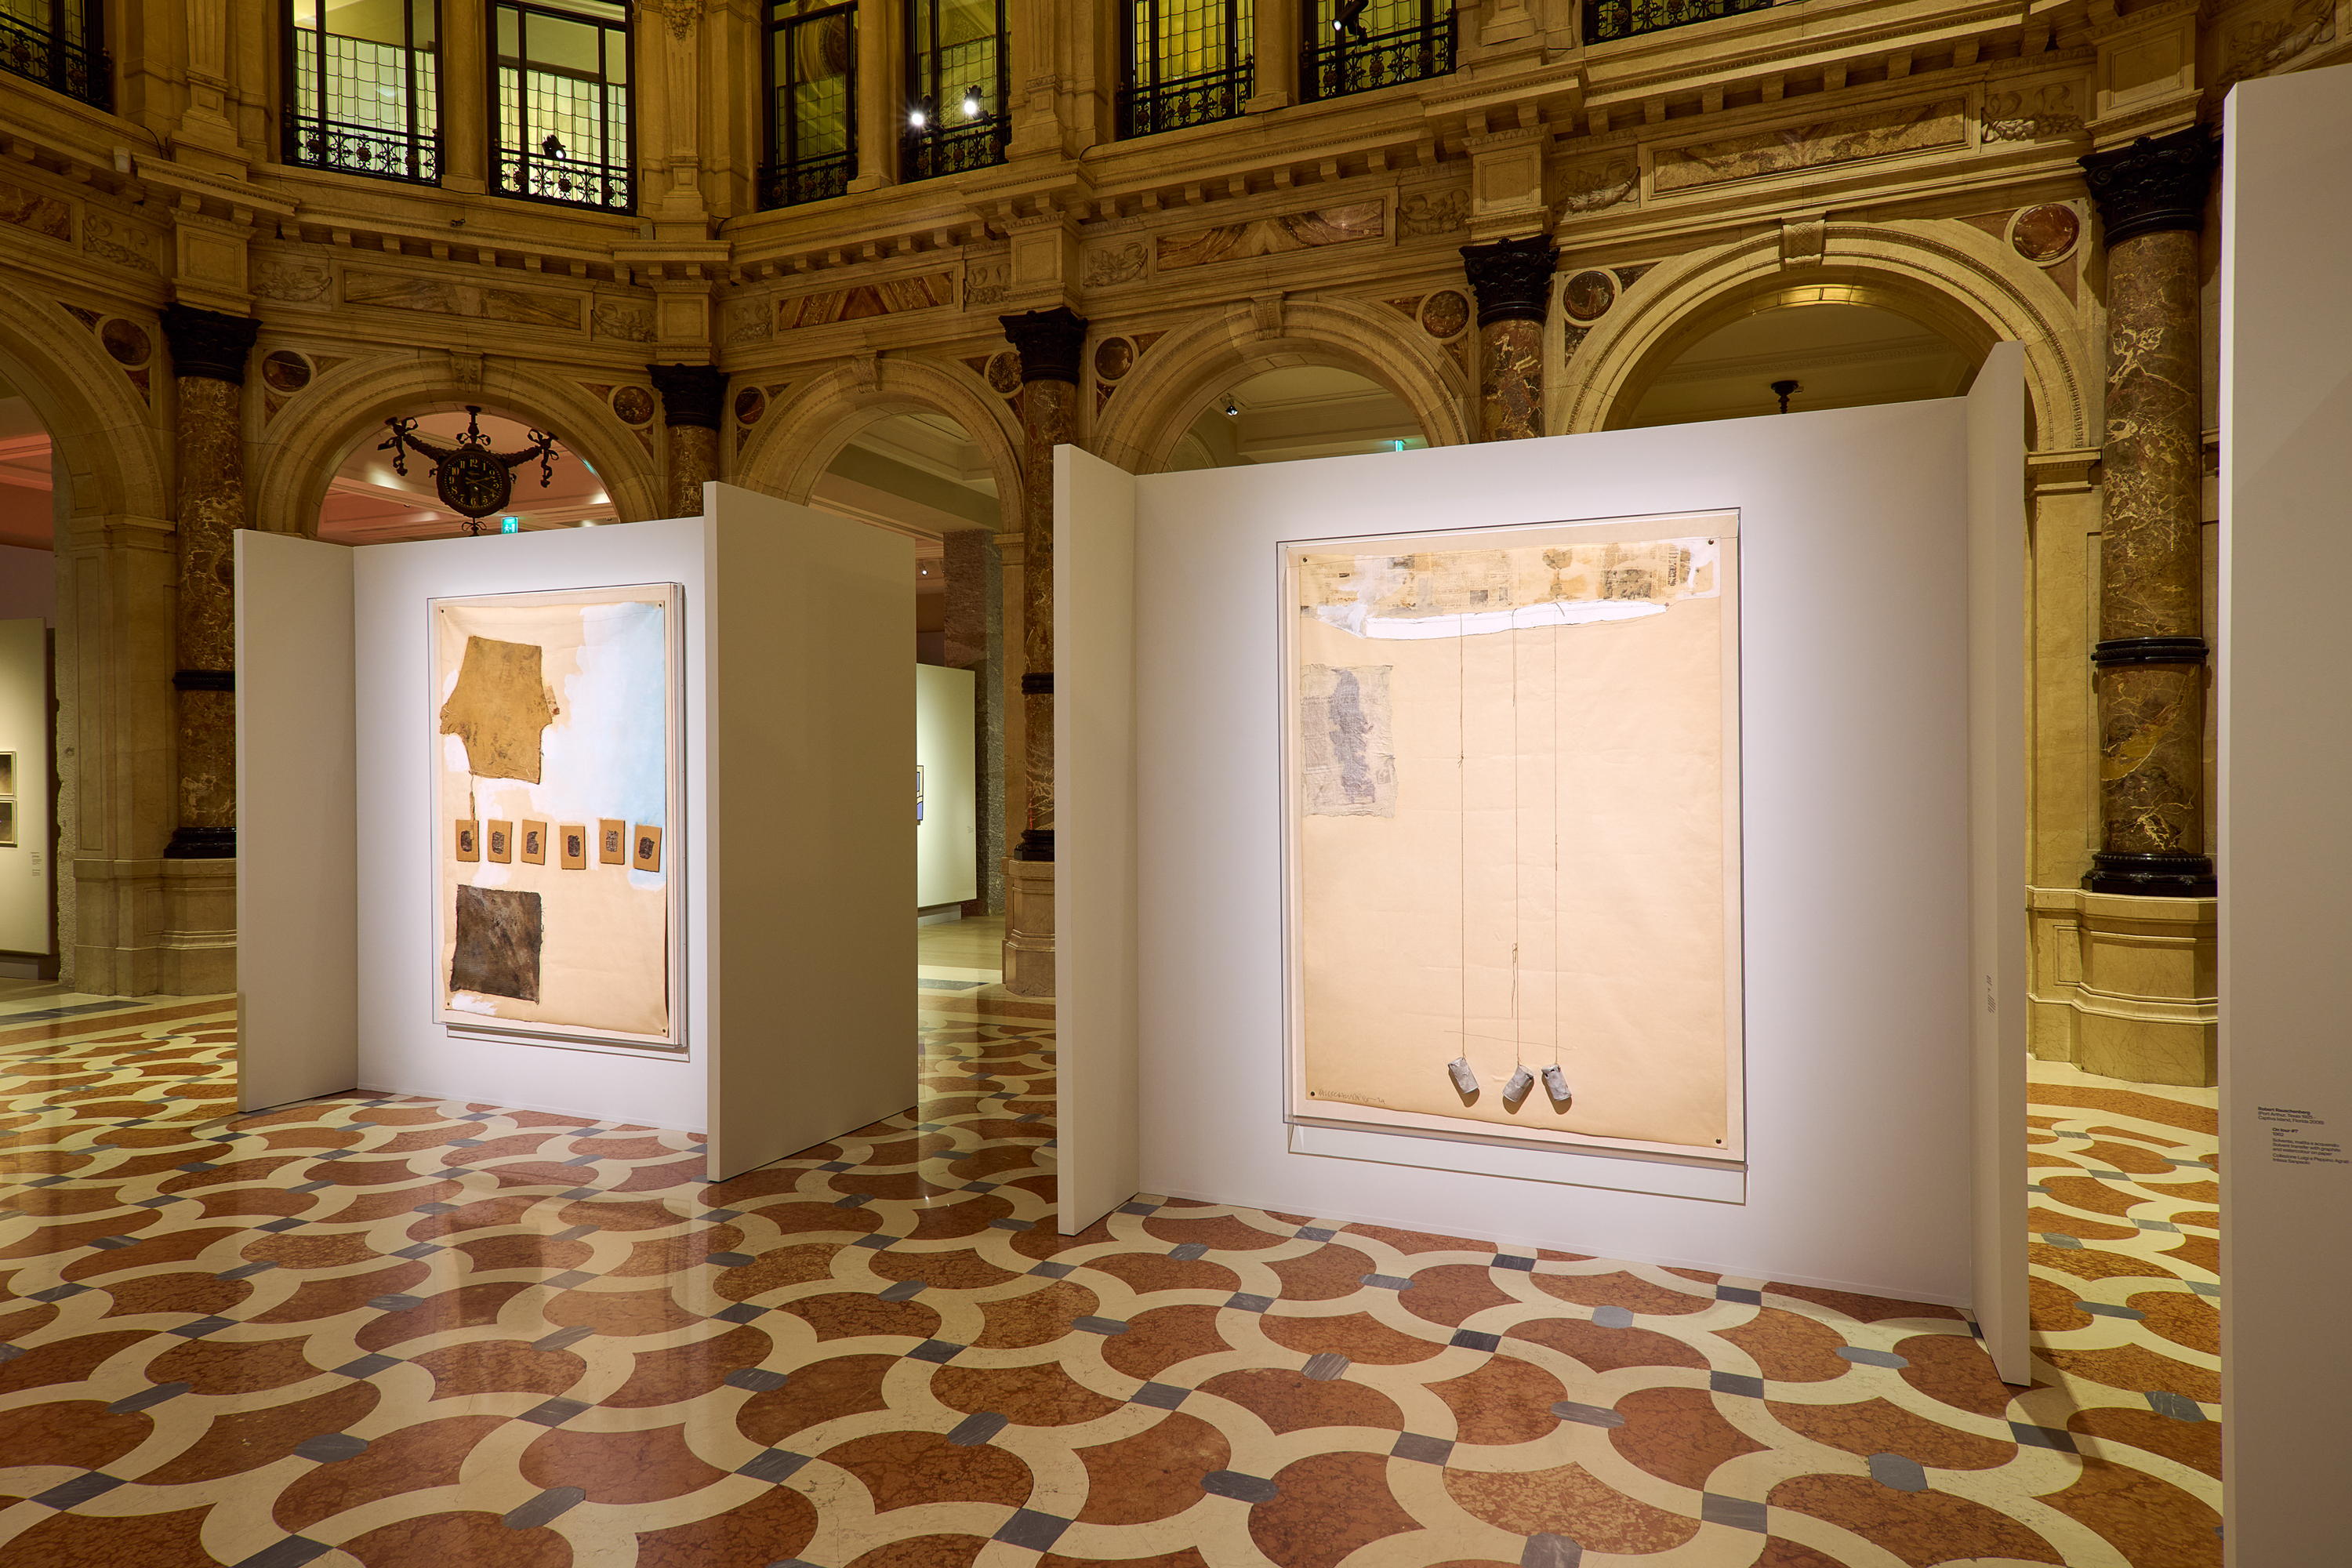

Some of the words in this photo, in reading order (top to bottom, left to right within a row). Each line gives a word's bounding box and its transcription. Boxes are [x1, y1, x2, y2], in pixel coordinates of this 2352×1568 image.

[470, 459, 477, 467] 12
[489, 470, 495, 478] 2
[493, 480, 499, 488] 3
[452, 486, 458, 495] 8
[459, 494, 465, 503] 7
